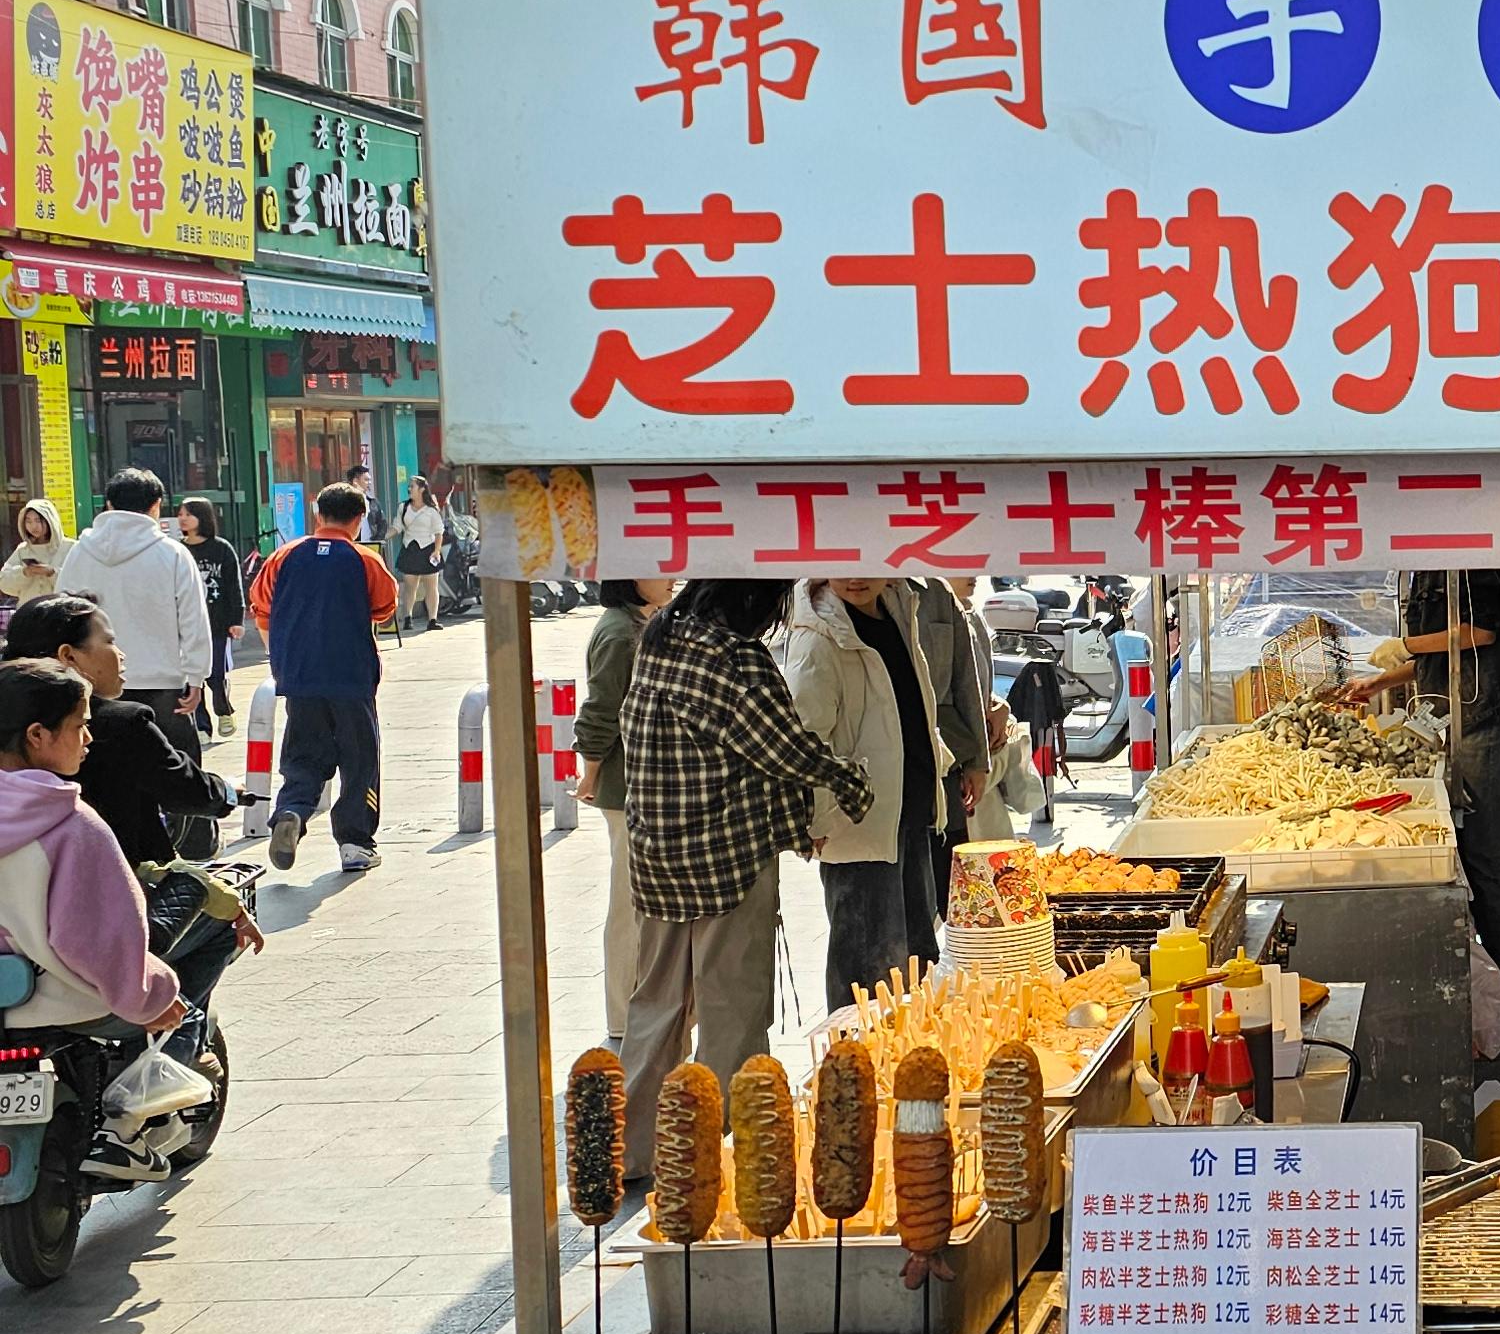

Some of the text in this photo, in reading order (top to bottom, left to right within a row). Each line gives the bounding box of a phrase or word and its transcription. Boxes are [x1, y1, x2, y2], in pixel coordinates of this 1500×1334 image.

[75, 26, 169, 141] 馋嘴
[179, 58, 246, 121] 鸡公煲
[36, 86, 56, 195] 灰太狼
[178, 114, 246, 170] 啵啵鱼
[313, 113, 370, 162] 老字号
[75, 128, 167, 235] 炸串
[180, 168, 248, 223] 砂锅粉
[257, 117, 281, 234] 中国
[286, 160, 411, 252] 兰州拉面
[53, 268, 177, 307] 重庆公鸡煲
[100, 335, 196, 380] 兰州拉面
[1189, 1146, 1302, 1176] 价目表
[1083, 1189, 1406, 1216] 柴鱼半芝士热狗 12元 柴鱼全芝士 14元
[1082, 1227, 1406, 1252] 海苔半芝士热狗 12元 海苔全芝士 14元
[1081, 1265, 1406, 1289] 肉松半芝士热狗 12元 肉松全芝士 14元
[1079, 1302, 1406, 1325] 彩糖半芝士热狗 12元 彩糖全芝士 14元
